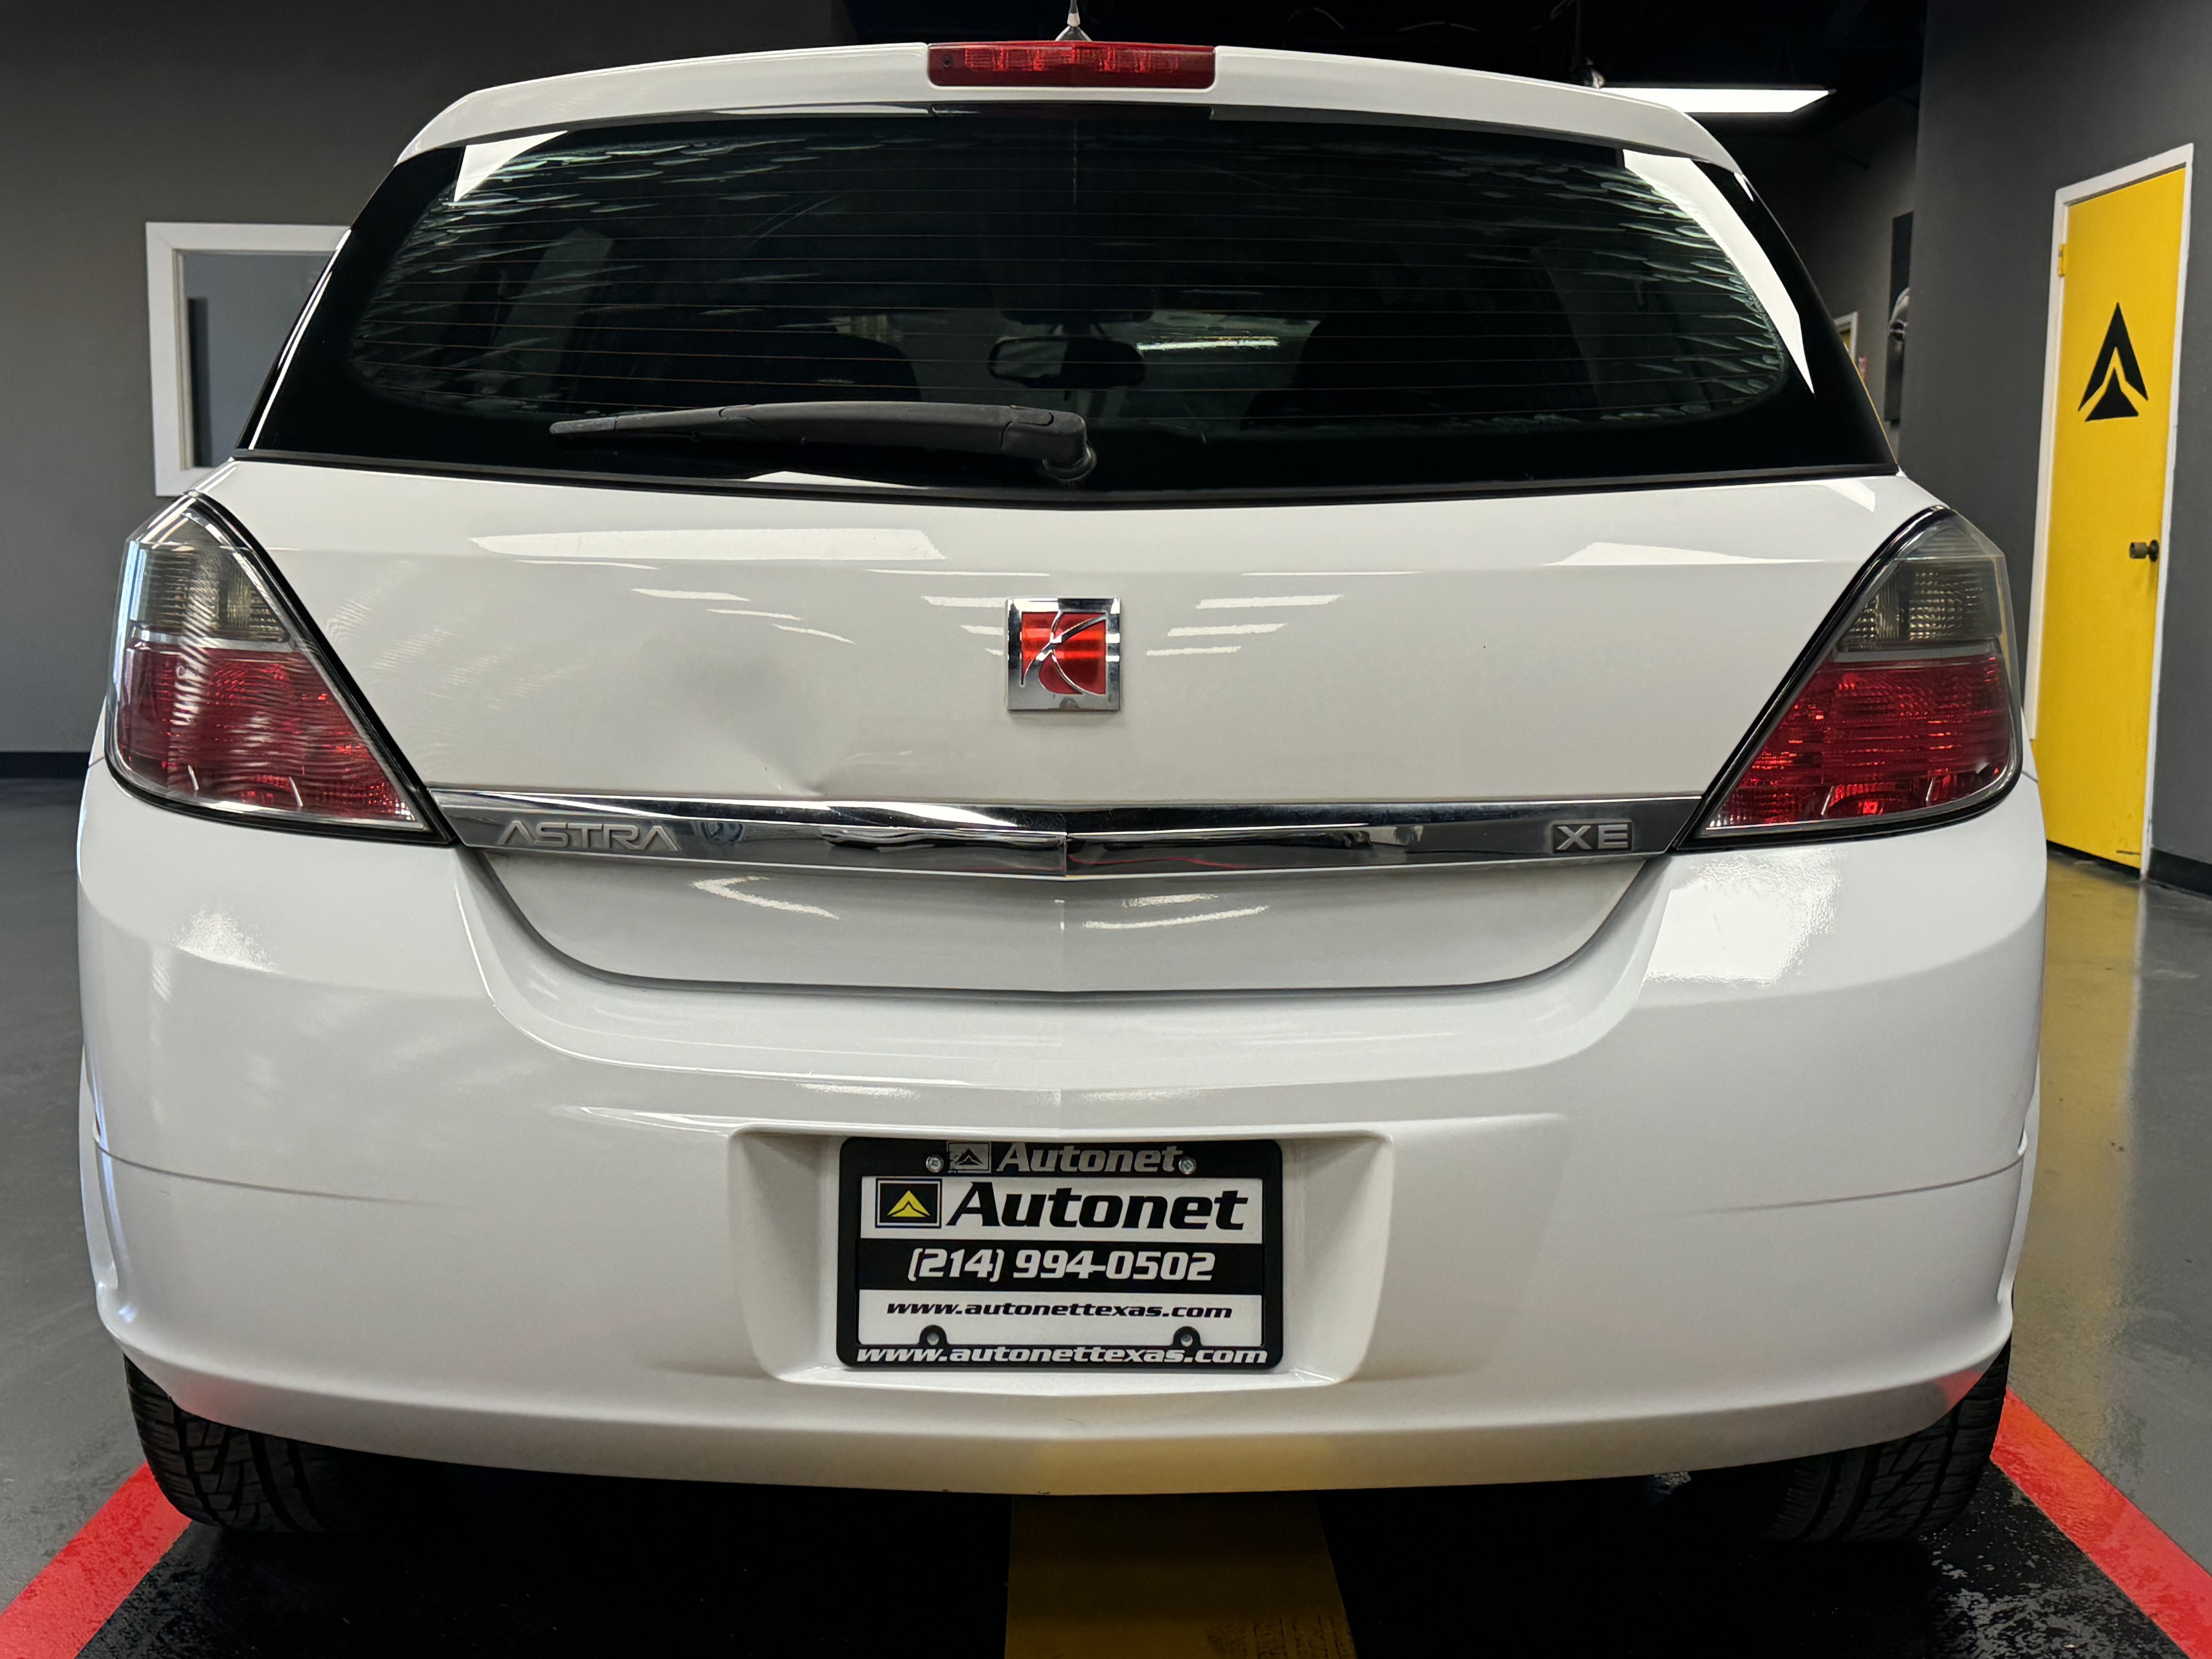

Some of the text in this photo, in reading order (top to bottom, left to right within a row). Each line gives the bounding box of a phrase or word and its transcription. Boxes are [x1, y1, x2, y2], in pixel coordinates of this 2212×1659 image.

[497, 820, 680, 852] ASTRA
[1556, 824, 1628, 850] XE
[996, 1142, 1183, 1173] Autonet
[946, 1182, 1248, 1230] Autonet
[908, 1248, 1216, 1282] (214) 994-0502
[886, 1302, 1232, 1318] www.autonettexas.com
[857, 1346, 1267, 1364] www.autonettexas.com
